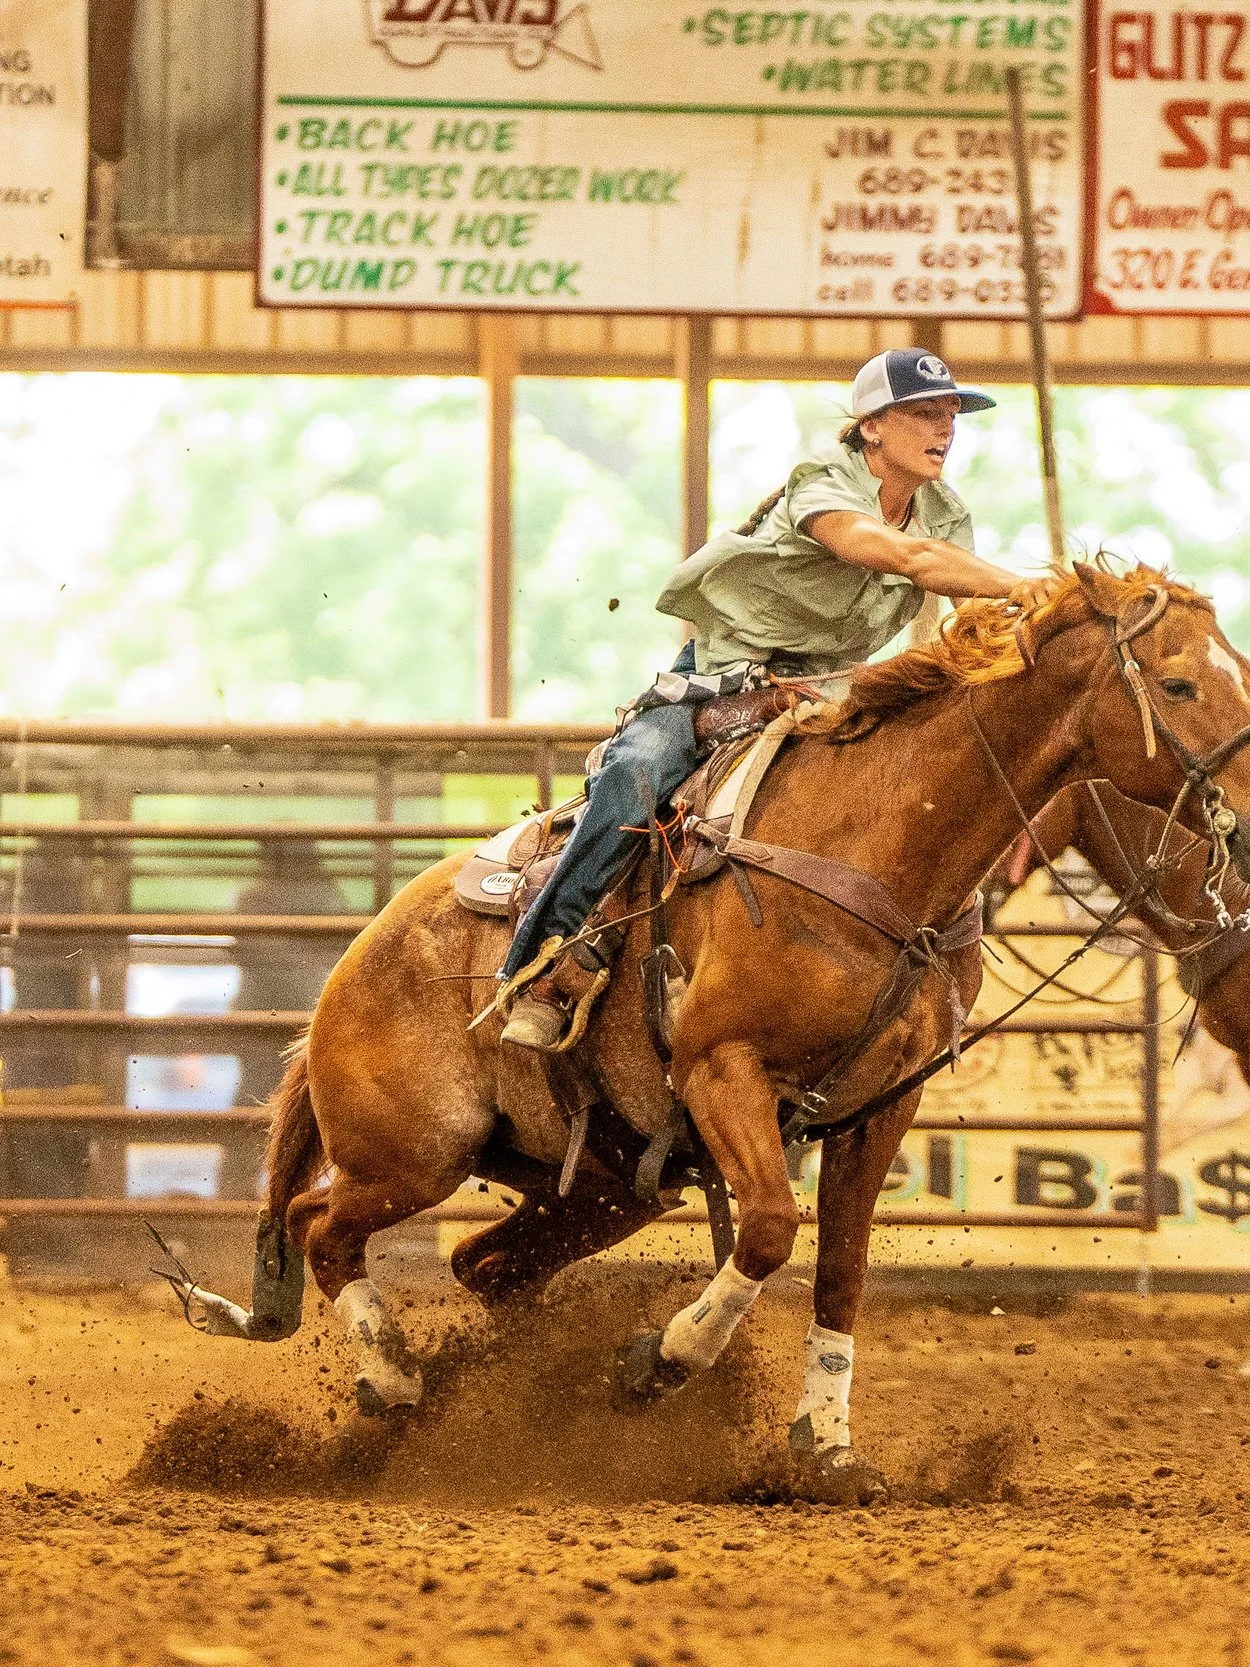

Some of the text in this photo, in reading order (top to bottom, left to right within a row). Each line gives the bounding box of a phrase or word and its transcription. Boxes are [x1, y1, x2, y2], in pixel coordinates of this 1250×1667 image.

[701, 9, 1073, 51] SEPTIC SYSTEMS
[1110, 12, 1247, 82] GLITZ
[780, 58, 932, 96] WATER
[298, 118, 518, 153] BACK HOE
[824, 127, 893, 161] JIM
[291, 163, 347, 198] ALL
[361, 165, 462, 200] TYPES
[588, 168, 687, 204] WORK
[302, 210, 540, 248] TRACK HOE
[956, 204, 1061, 236] DAVS
[288, 259, 583, 299] DUMP TRUCK
